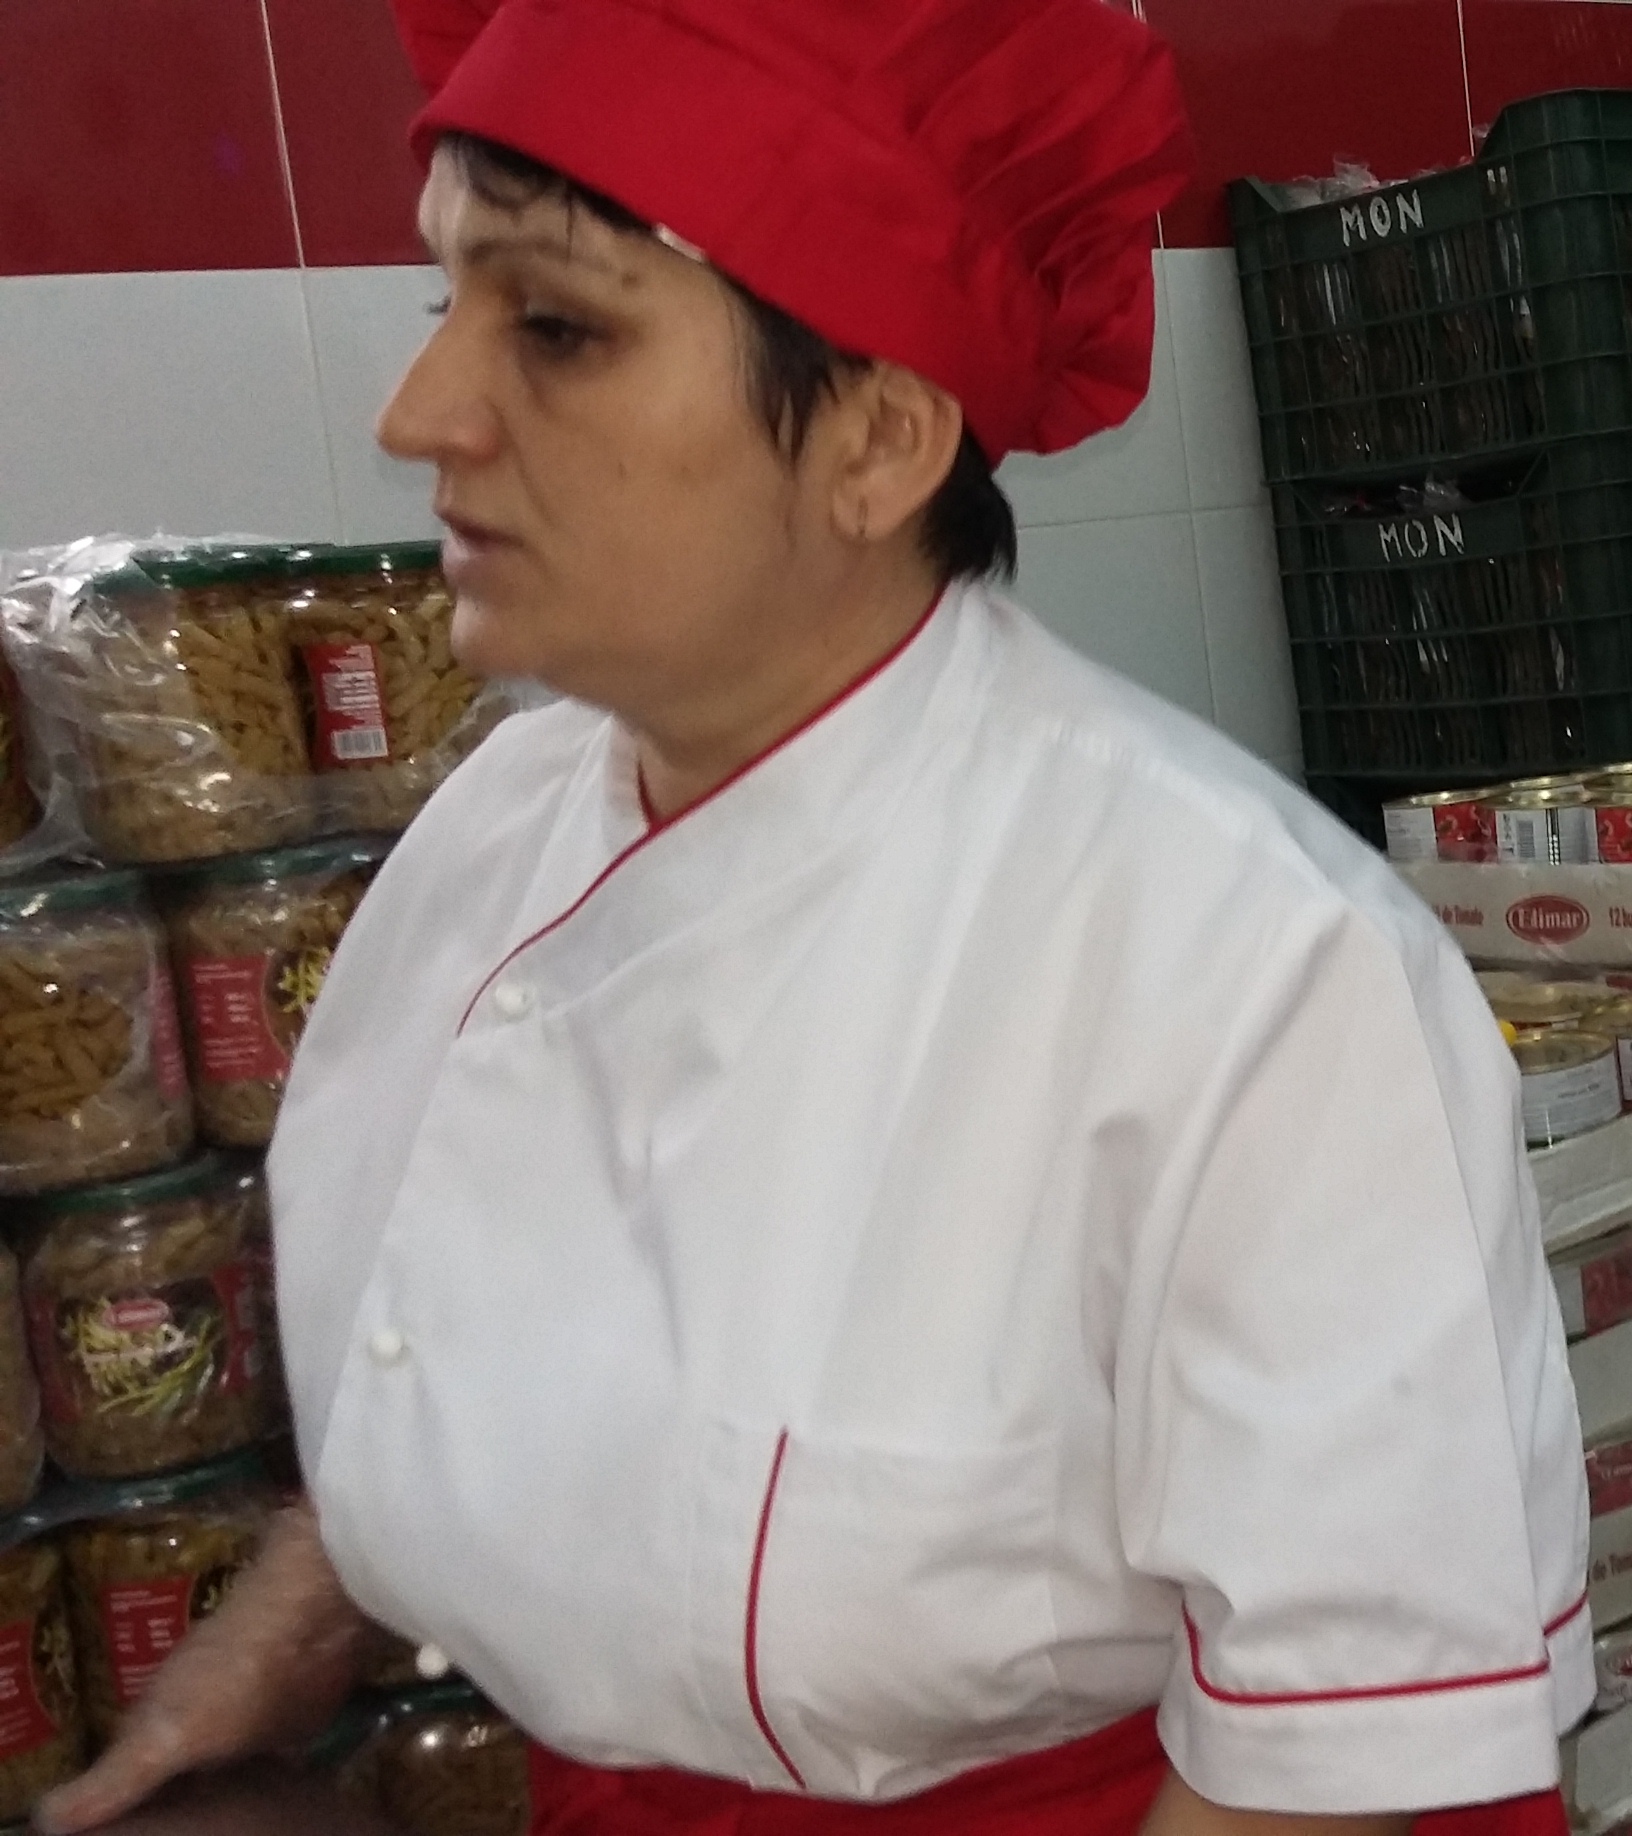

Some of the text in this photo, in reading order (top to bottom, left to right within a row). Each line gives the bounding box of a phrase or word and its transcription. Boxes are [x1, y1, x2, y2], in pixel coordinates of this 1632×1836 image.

[1339, 188, 1424, 247] MON
[1378, 512, 1465, 563] MON
[1517, 905, 1582, 930] Edimar
